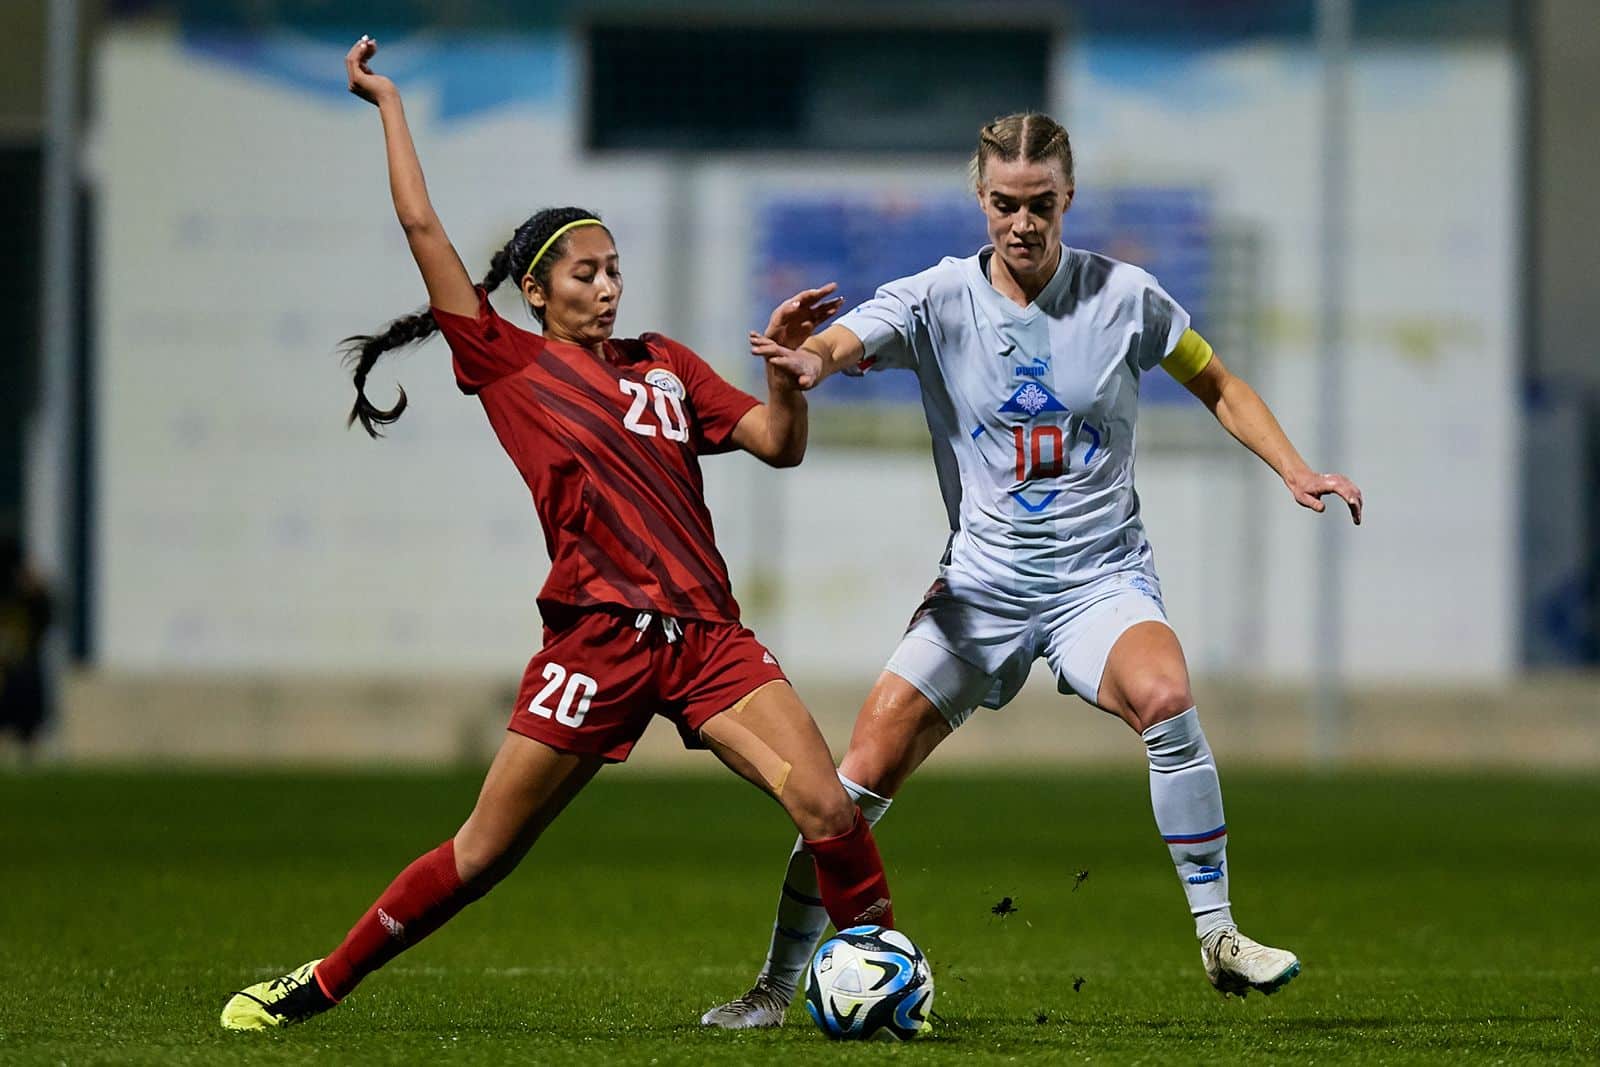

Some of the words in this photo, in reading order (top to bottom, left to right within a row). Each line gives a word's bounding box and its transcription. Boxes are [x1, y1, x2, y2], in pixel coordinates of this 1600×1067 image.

[1015, 366, 1045, 377] PUMA
[619, 378, 688, 443] 20
[1013, 425, 1063, 481] 10
[528, 662, 598, 728] 20
